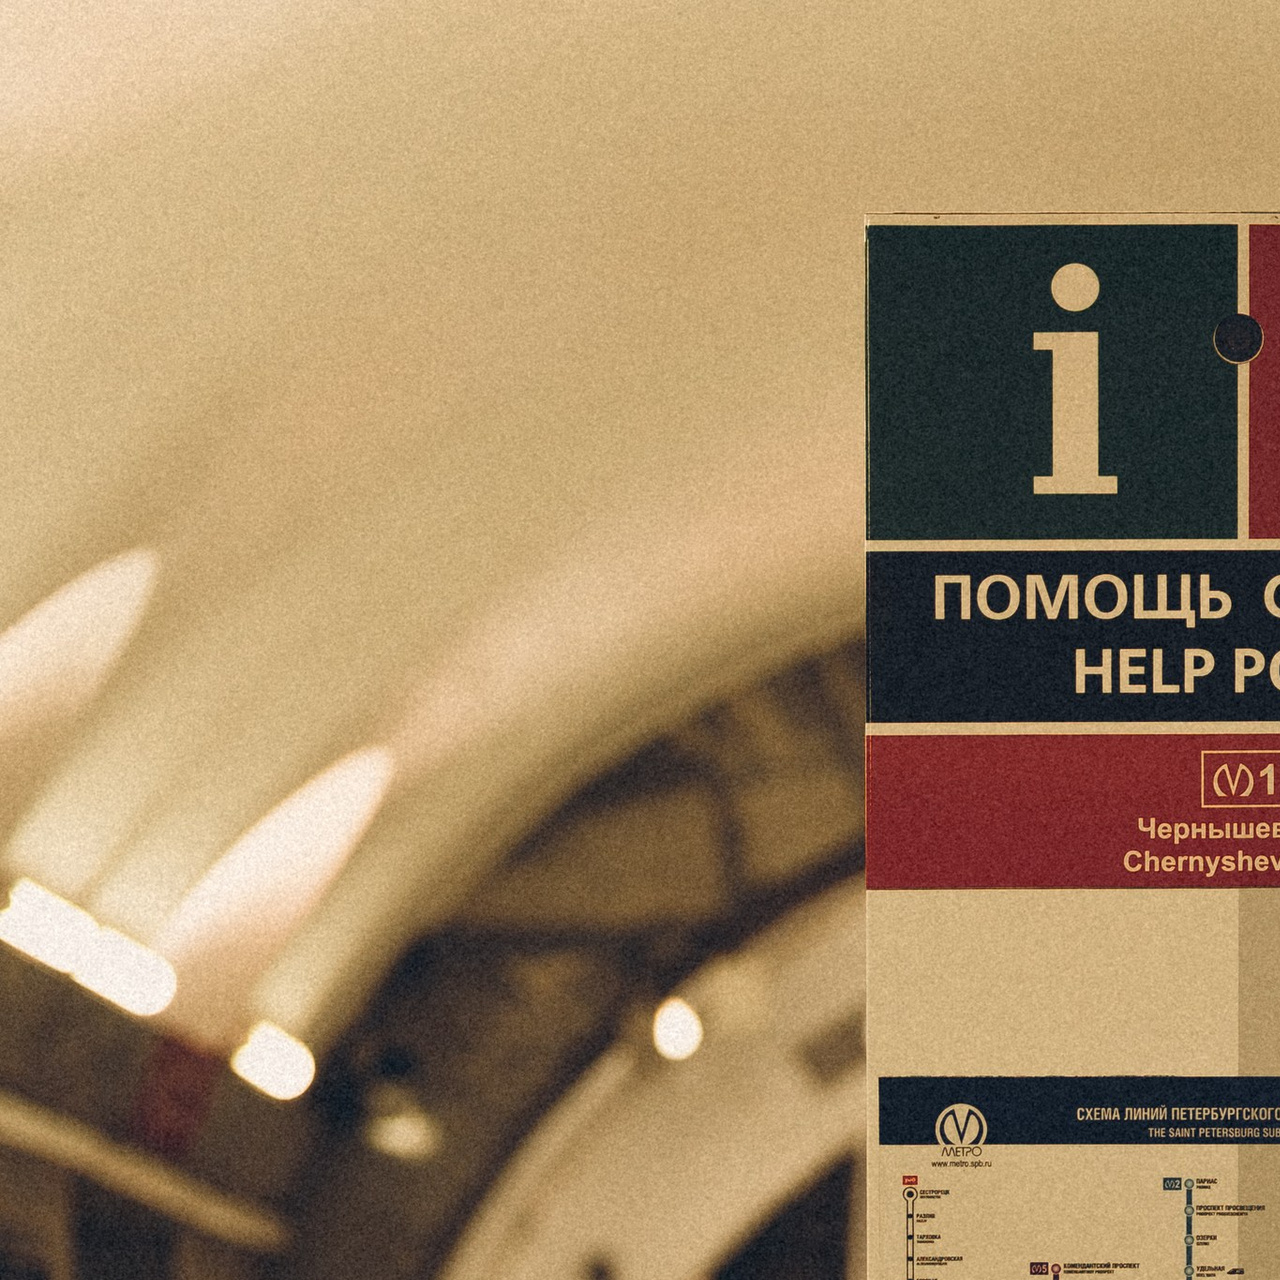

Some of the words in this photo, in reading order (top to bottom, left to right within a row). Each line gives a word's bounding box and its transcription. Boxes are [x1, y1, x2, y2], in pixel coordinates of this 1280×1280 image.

[1033, 263, 1118, 494] i
[933, 574, 1232, 628] ПОМОЩЬ
[1074, 647, 1216, 695] HELP
[1076, 1107, 1121, 1122] СХЕМА
[1123, 1104, 1168, 1122] ЛИНИЙ
[1148, 1127, 1167, 1139] THE
[1168, 1127, 1197, 1139] SAINT
[1198, 1127, 1260, 1139] PETERSBURG
[931, 1160, 993, 1169] www.metro.spb.ru
